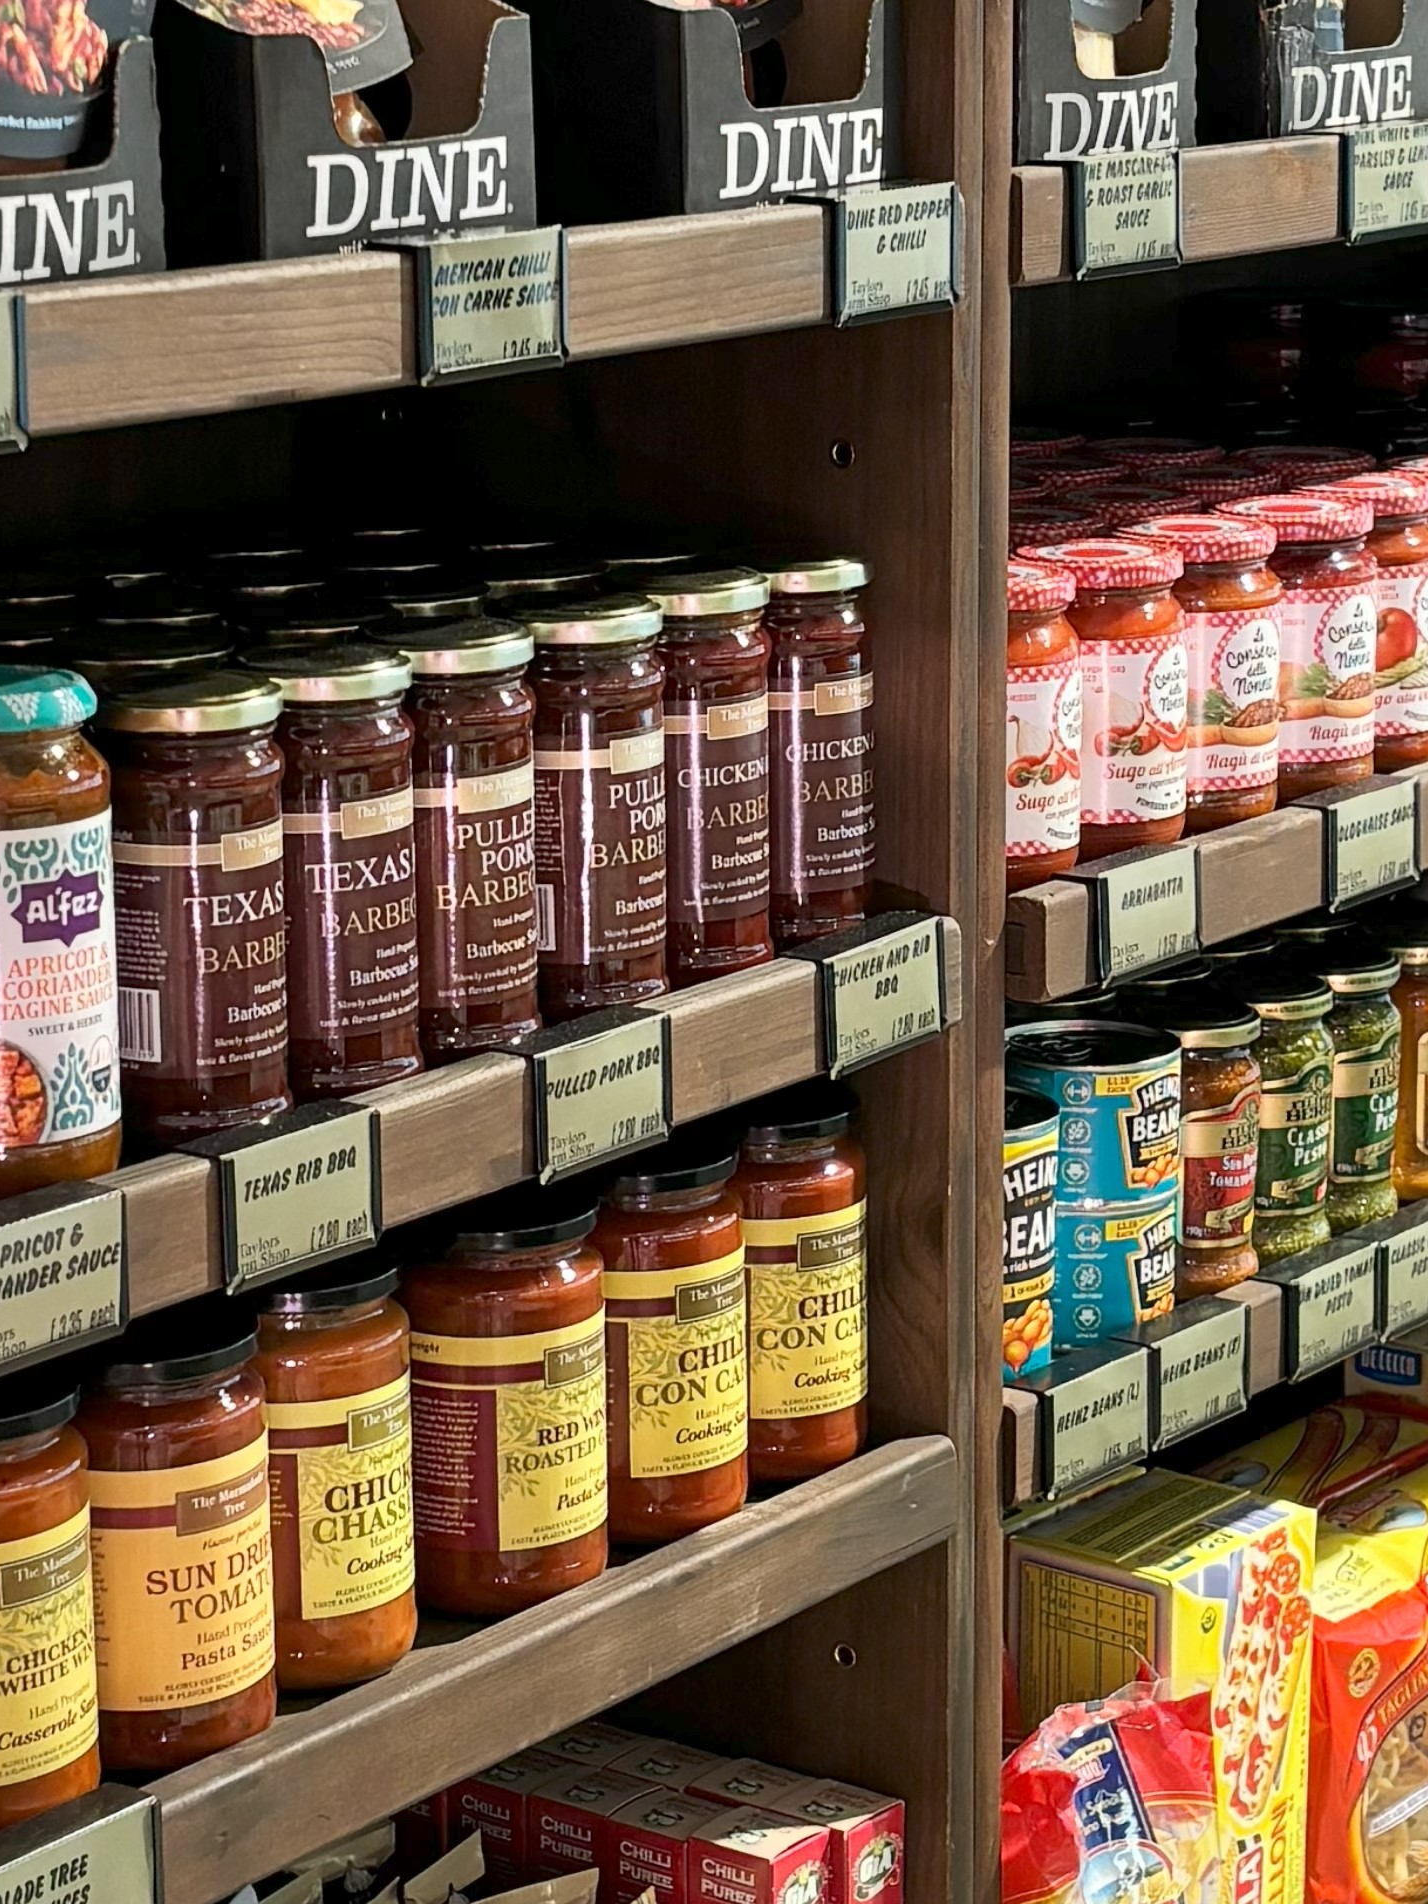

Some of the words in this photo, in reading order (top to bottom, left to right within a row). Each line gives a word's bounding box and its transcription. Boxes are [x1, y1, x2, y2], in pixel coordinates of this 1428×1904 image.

[1290, 55, 1413, 131] DINE
[1043, 82, 1179, 162] DINE
[719, 108, 885, 201] DINE
[306, 136, 508, 239] DINE
[847, 206, 875, 230] DINE
[880, 202, 902, 224] RED
[905, 198, 951, 223] PEPPER
[1115, 208, 1150, 230] SAUCE
[1103, 761, 1146, 780] Sugo
[6, 952, 92, 980] APRICOT
[885, 947, 906, 972] AND
[909, 933, 931, 959] RIB
[875, 973, 898, 998] BBQ
[0, 994, 72, 1024] TAGINE
[599, 1053, 634, 1084] PORK
[637, 1043, 660, 1070] BBQ
[243, 1166, 290, 1204] TEXAS
[293, 1156, 323, 1182] RIB
[326, 1145, 357, 1175] BBQ
[67, 1242, 120, 1282] SAUCE
[1190, 1345, 1225, 1374] BEANS
[1087, 1395, 1123, 1423] BEANS
[146, 1563, 215, 1595] SUN
[181, 1642, 236, 1669] Pasta
[242, 1620, 274, 1652] Sauce
[50, 1854, 88, 1891] TREE
[701, 1858, 756, 1882] CHILLI
